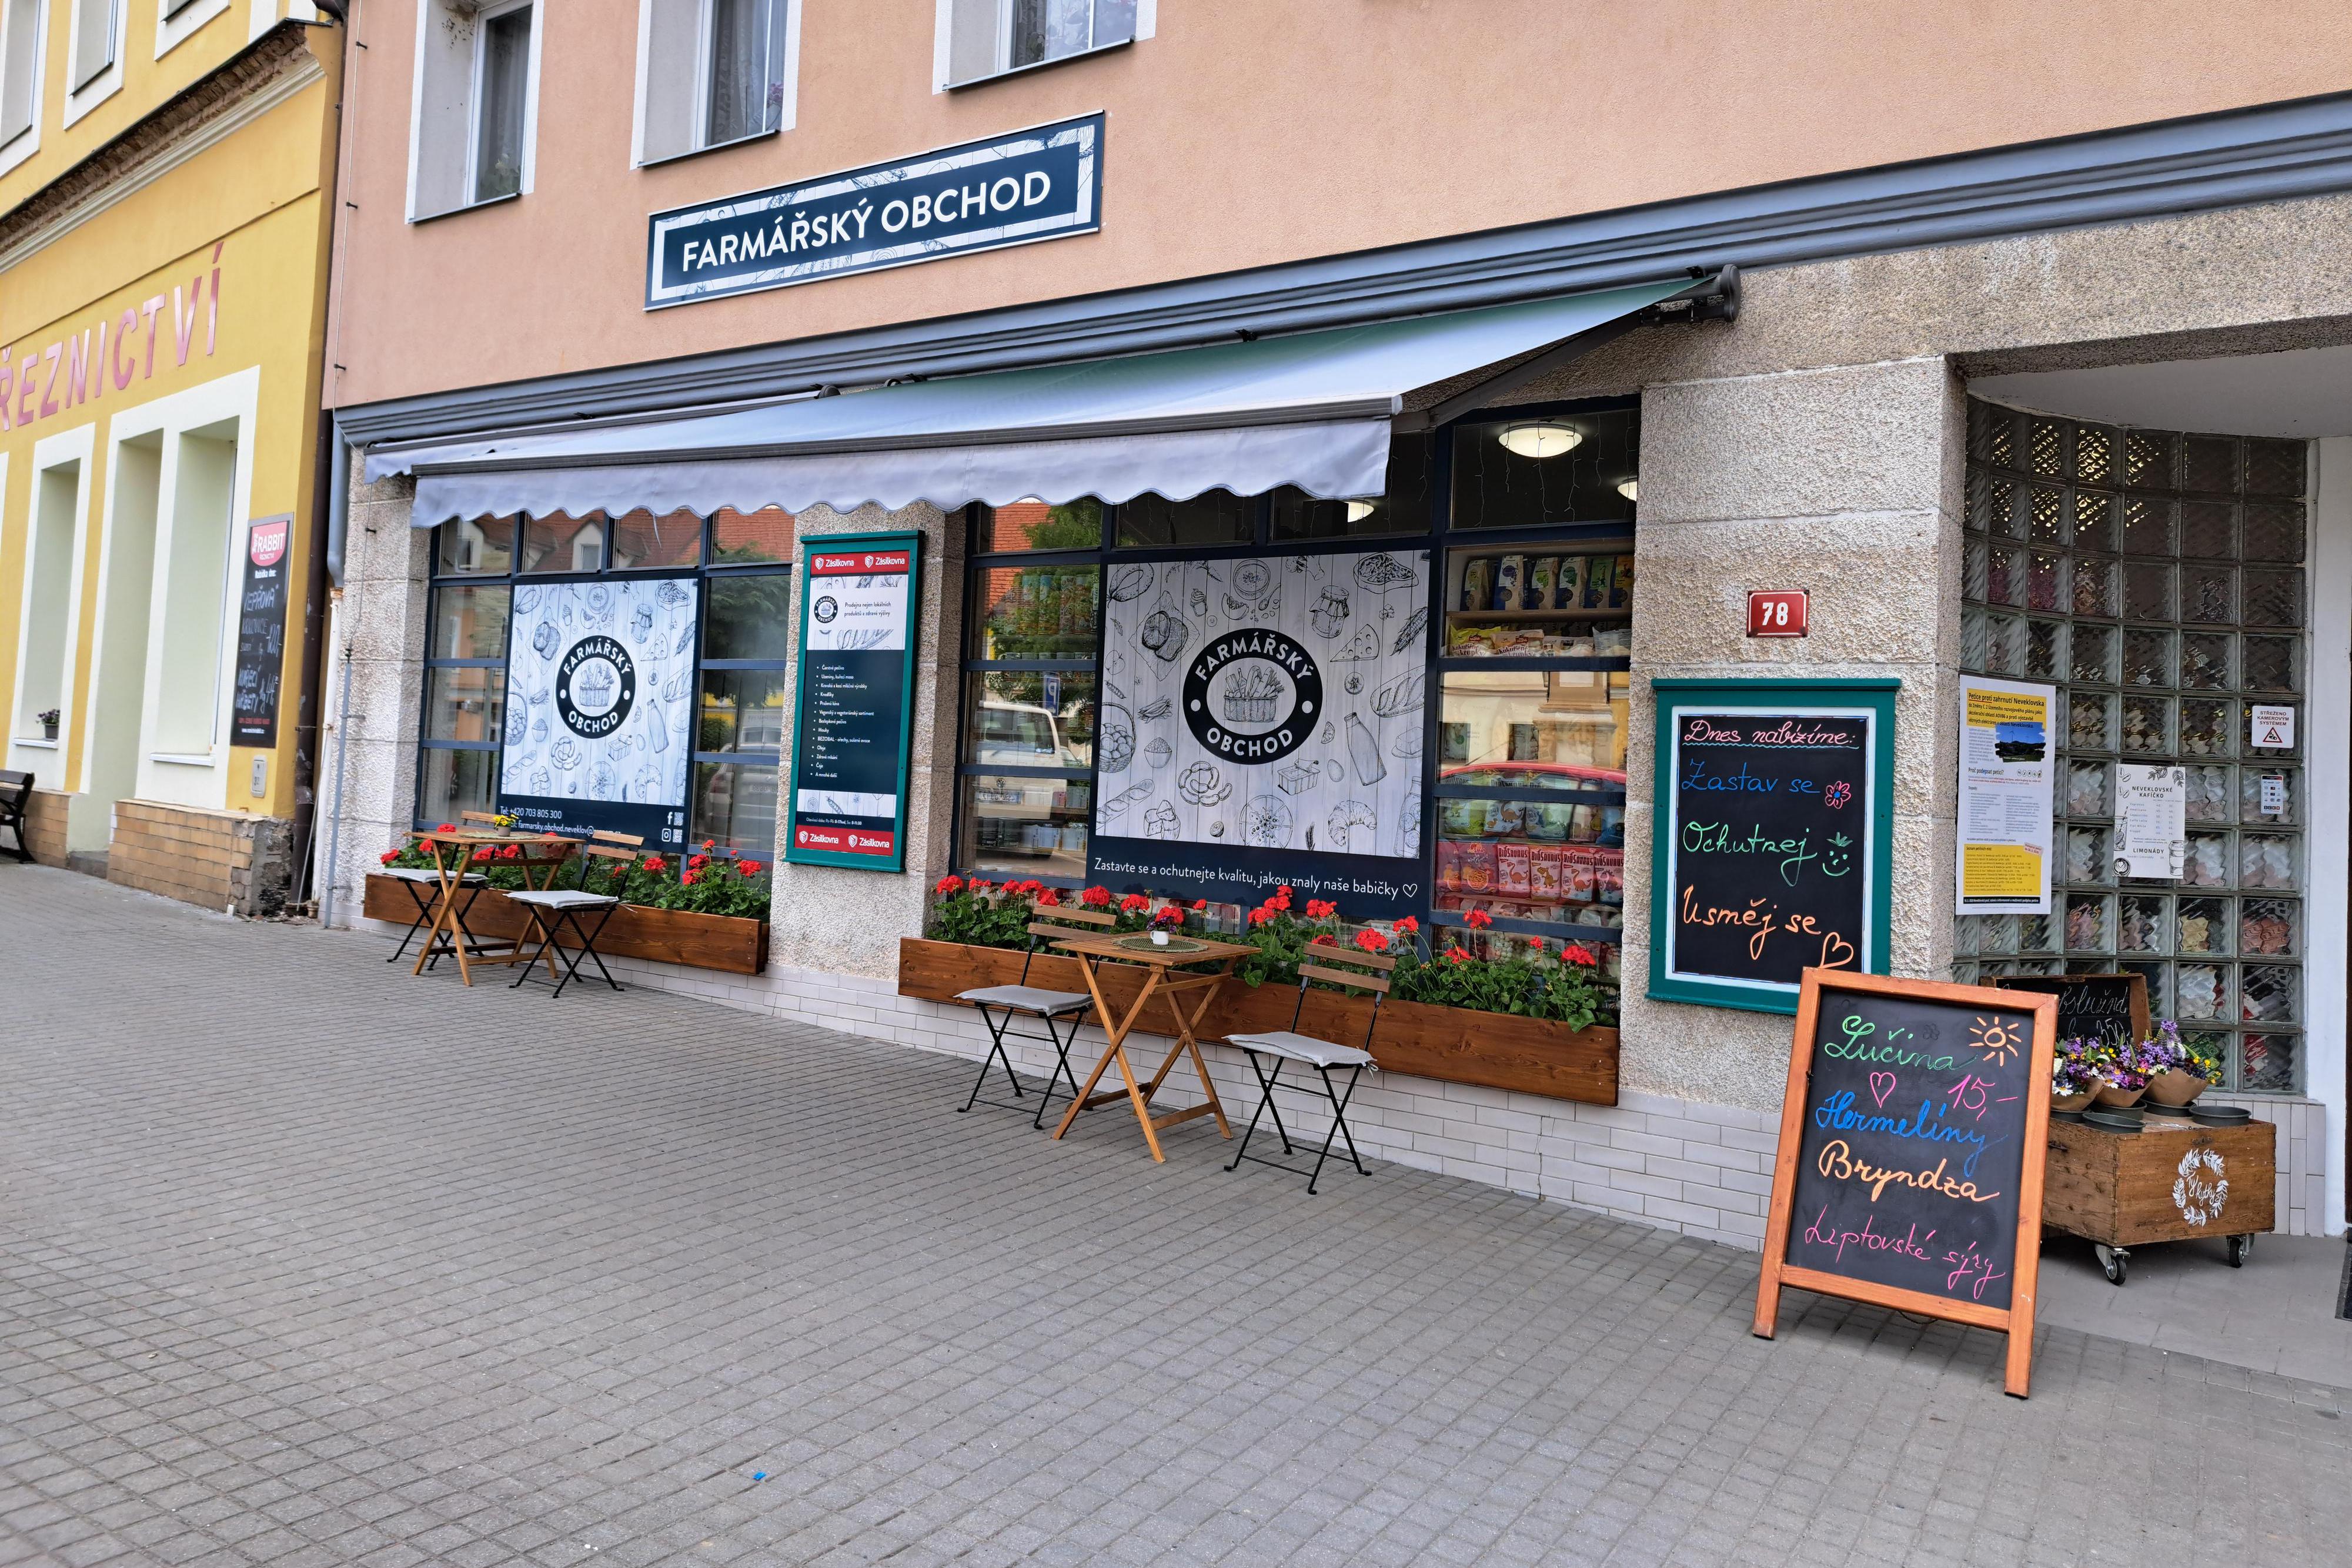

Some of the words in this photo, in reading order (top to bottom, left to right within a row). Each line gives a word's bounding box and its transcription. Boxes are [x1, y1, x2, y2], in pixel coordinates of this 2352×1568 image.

[683, 198, 873, 272] FARMÁŘSKÝ
[881, 171, 1051, 233] OBCHOD
[258, 533, 285, 553] RABBIT
[826, 559, 854, 567] Zásilkovna
[875, 557, 905, 566] Zásilkovna
[1762, 602, 1789, 626] 78
[563, 638, 632, 675] FARMÁŘSKÝ
[1195, 632, 1314, 681] FARMÁŘSKÝ
[2013, 698, 2044, 707] Neveklovska
[569, 711, 617, 733] OBCHOD
[1684, 720, 1741, 742] Dnes
[1753, 721, 1856, 745] nabízíme:
[1207, 727, 1292, 757] OBCHOD
[1682, 758, 1779, 791] Zastav
[1789, 778, 1820, 793] se
[510, 807, 524, 816] +420
[525, 808, 536, 817] 703
[537, 809, 549, 818] 805
[550, 810, 562, 820] 300
[809, 834, 839, 844] Zásilkovna
[859, 838, 890, 848] Zásilkovna
[1683, 821, 1818, 887] Ochutnej
[1094, 857, 1135, 874] Zastavte
[1138, 865, 1149, 874] se
[1151, 867, 1157, 875] a
[1160, 865, 1215, 883] ochutnejte
[1218, 868, 1257, 886] kvalitu,
[1258, 870, 1288, 888] jakou
[1292, 874, 1320, 893] znaly
[1324, 876, 1349, 892] naše
[1353, 878, 1399, 900] babičky
[1684, 884, 1777, 960] Usměj
[1785, 915, 1821, 935] se
[1825, 1015, 1979, 1071] Lučina
[1816, 1089, 2008, 1177] Hermelíny
[1819, 1140, 2000, 1202] Bryndza
[2186, 1171, 2199, 1197] Ty
[2196, 1182, 2216, 1206] kytky
[1805, 1204, 1936, 1263] Liptovské
[1943, 1241, 2006, 1299] sýry
